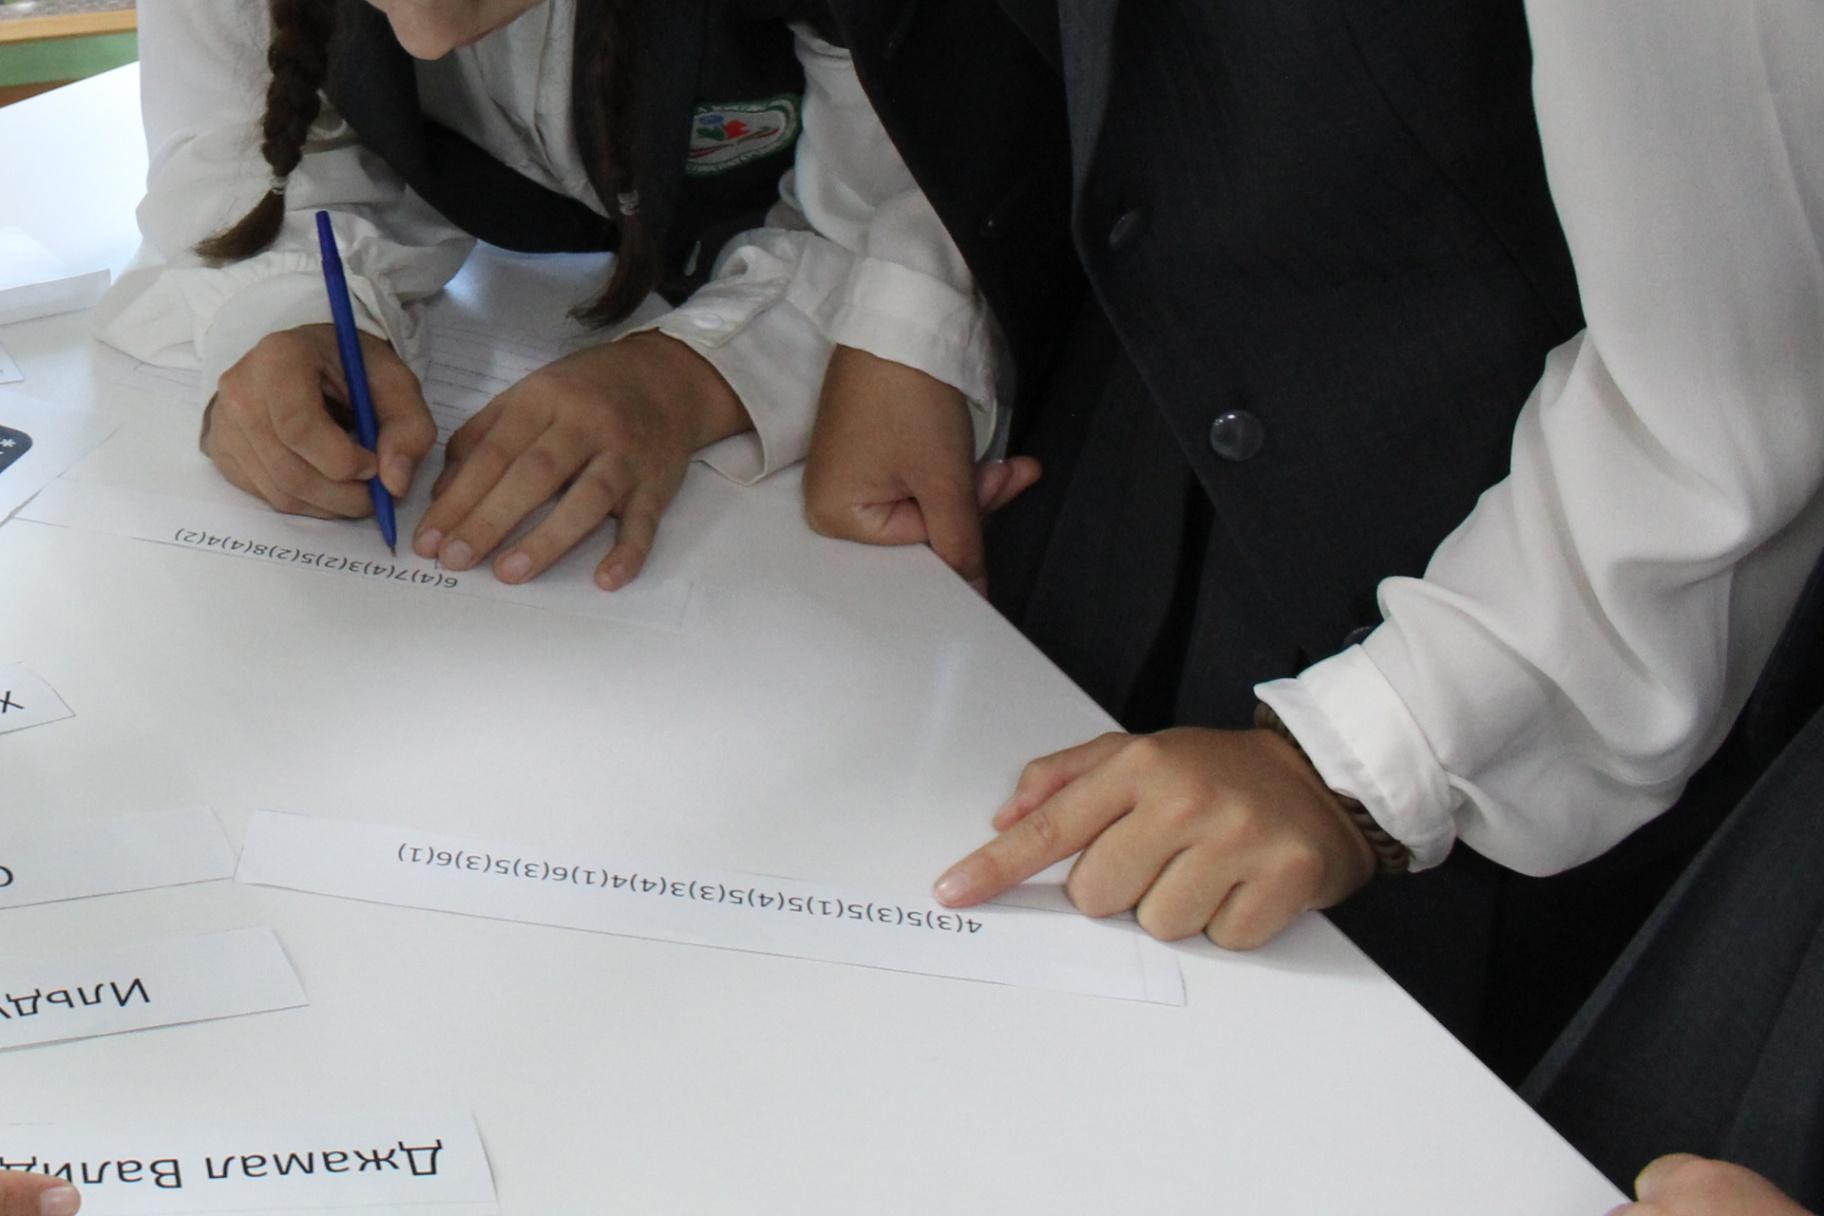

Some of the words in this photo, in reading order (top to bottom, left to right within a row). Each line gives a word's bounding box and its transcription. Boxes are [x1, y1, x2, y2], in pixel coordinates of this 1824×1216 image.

[174, 528, 458, 589] 6(4)7(4)3(2)5(2)8(4)4(2)
[396, 843, 983, 935] 4(3)5(3)5(1)5(4)5(3)3(4)4(1)6(3)5(3)6(1)
[205, 1139, 443, 1181] Джамал
